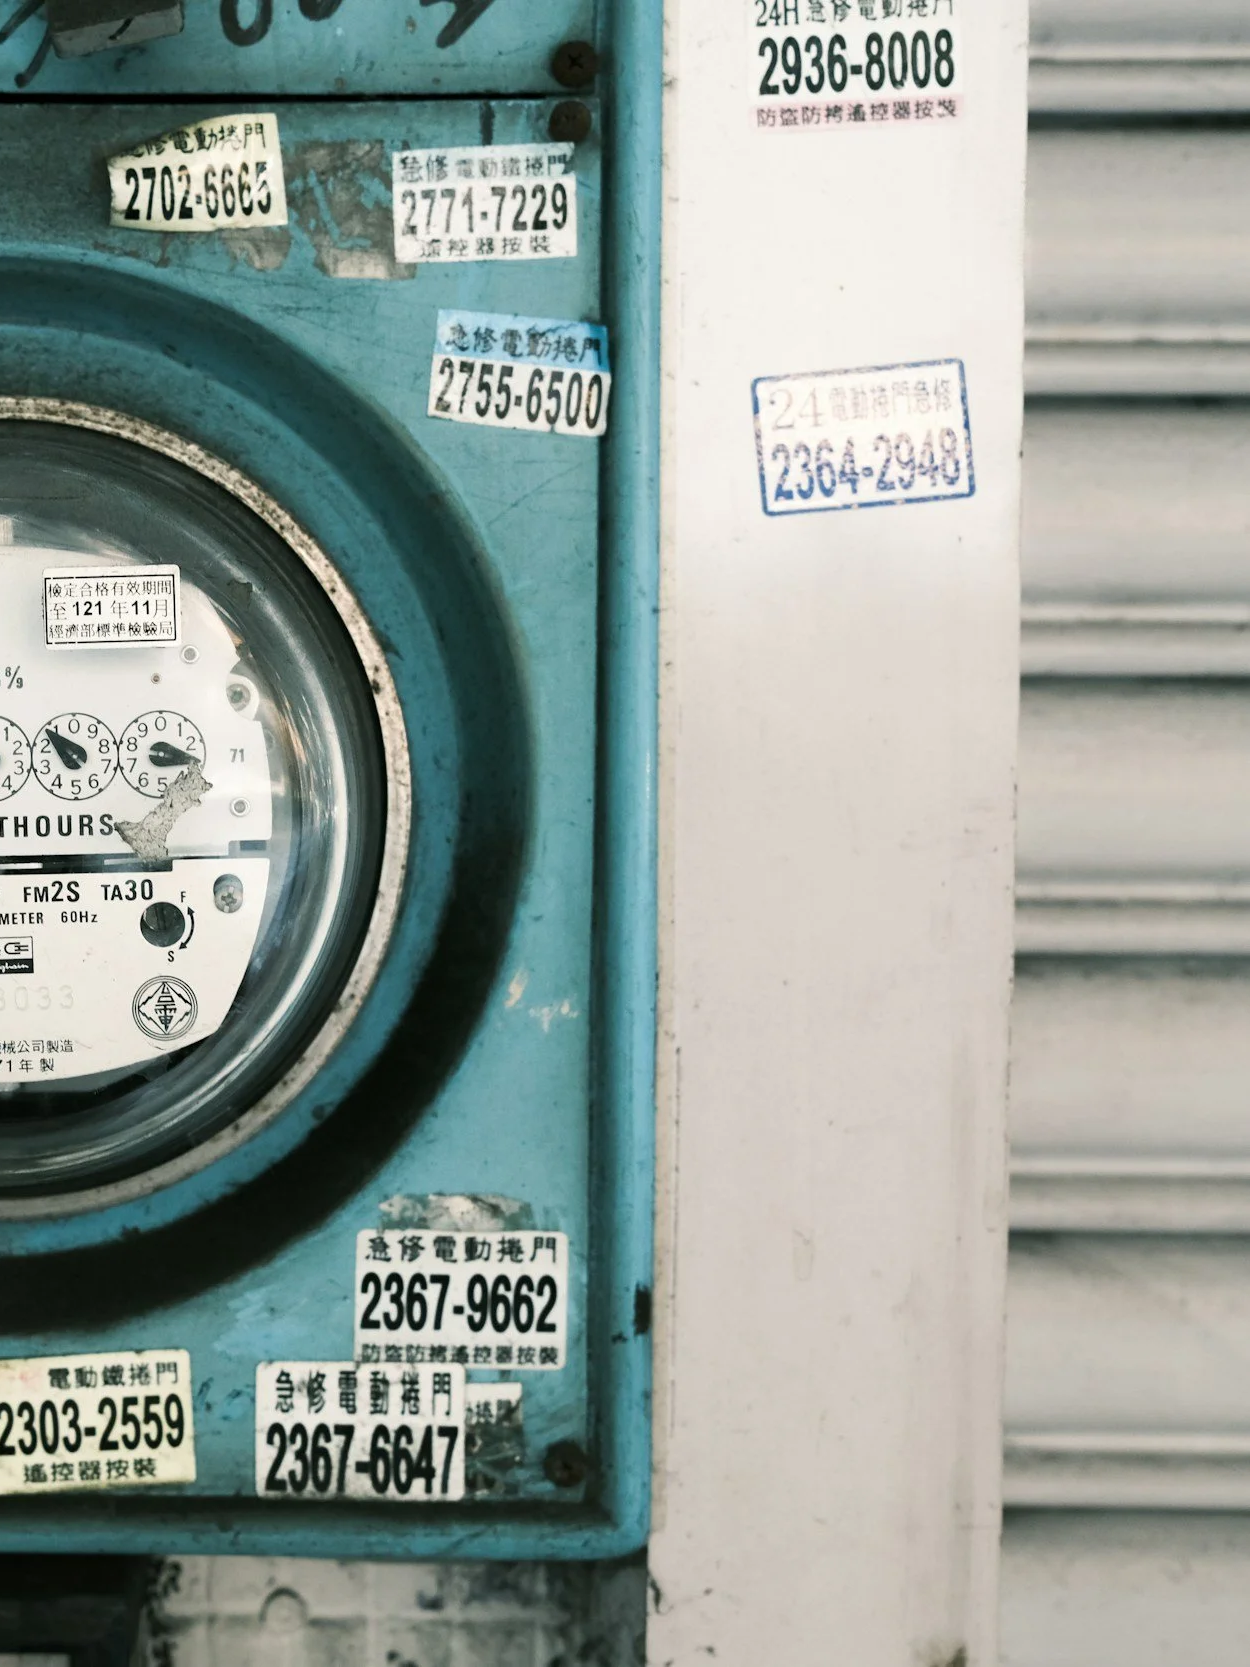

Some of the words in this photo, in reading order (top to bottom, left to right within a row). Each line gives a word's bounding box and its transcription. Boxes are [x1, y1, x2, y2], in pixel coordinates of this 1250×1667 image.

[758, 29, 954, 95] 2936-8008
[124, 161, 272, 221] 2702-6665
[401, 183, 568, 235] 2771-7229
[435, 357, 603, 430] 2755-6500
[771, 427, 961, 502] 2364-2948
[48, 580, 172, 598] 檢定合格有效期間
[49, 621, 173, 639] 經濟部標準檢驗局
[67, 718, 81, 734] 0
[87, 723, 99, 739] 9
[137, 722, 149, 738] 9
[154, 716, 167, 732] 0
[177, 722, 182, 737] 1
[3, 726, 9, 742] 1
[12, 740, 23, 756] 2
[40, 739, 51, 753] 2
[98, 738, 110, 754] 8
[126, 736, 138, 752] 8
[185, 736, 196, 751] 2
[230, 748, 245, 763] 71
[14, 759, 25, 775] 3
[39, 759, 51, 775] 3
[101, 758, 112, 774] 7
[126, 757, 138, 773] 7
[1, 774, 13, 791] 4
[51, 773, 63, 790] 4
[70, 779, 82, 796] 5
[88, 773, 99, 789] 6
[137, 772, 149, 788] 6
[157, 777, 169, 793] 5
[23, 881, 80, 903] FM2S
[100, 879, 154, 901] TA30
[181, 891, 187, 903] F
[61, 911, 98, 924] 60Hz
[168, 951, 175, 962] S
[365, 1236, 558, 1264] 急修電動捲門
[359, 1271, 559, 1334] 2367-9662
[48, 1361, 178, 1390] 電動鐵捲門
[275, 1370, 452, 1417] 急修電動捲門
[264, 1422, 459, 1495] 2367-6647
[23, 1457, 157, 1485] 遙控器按裝
